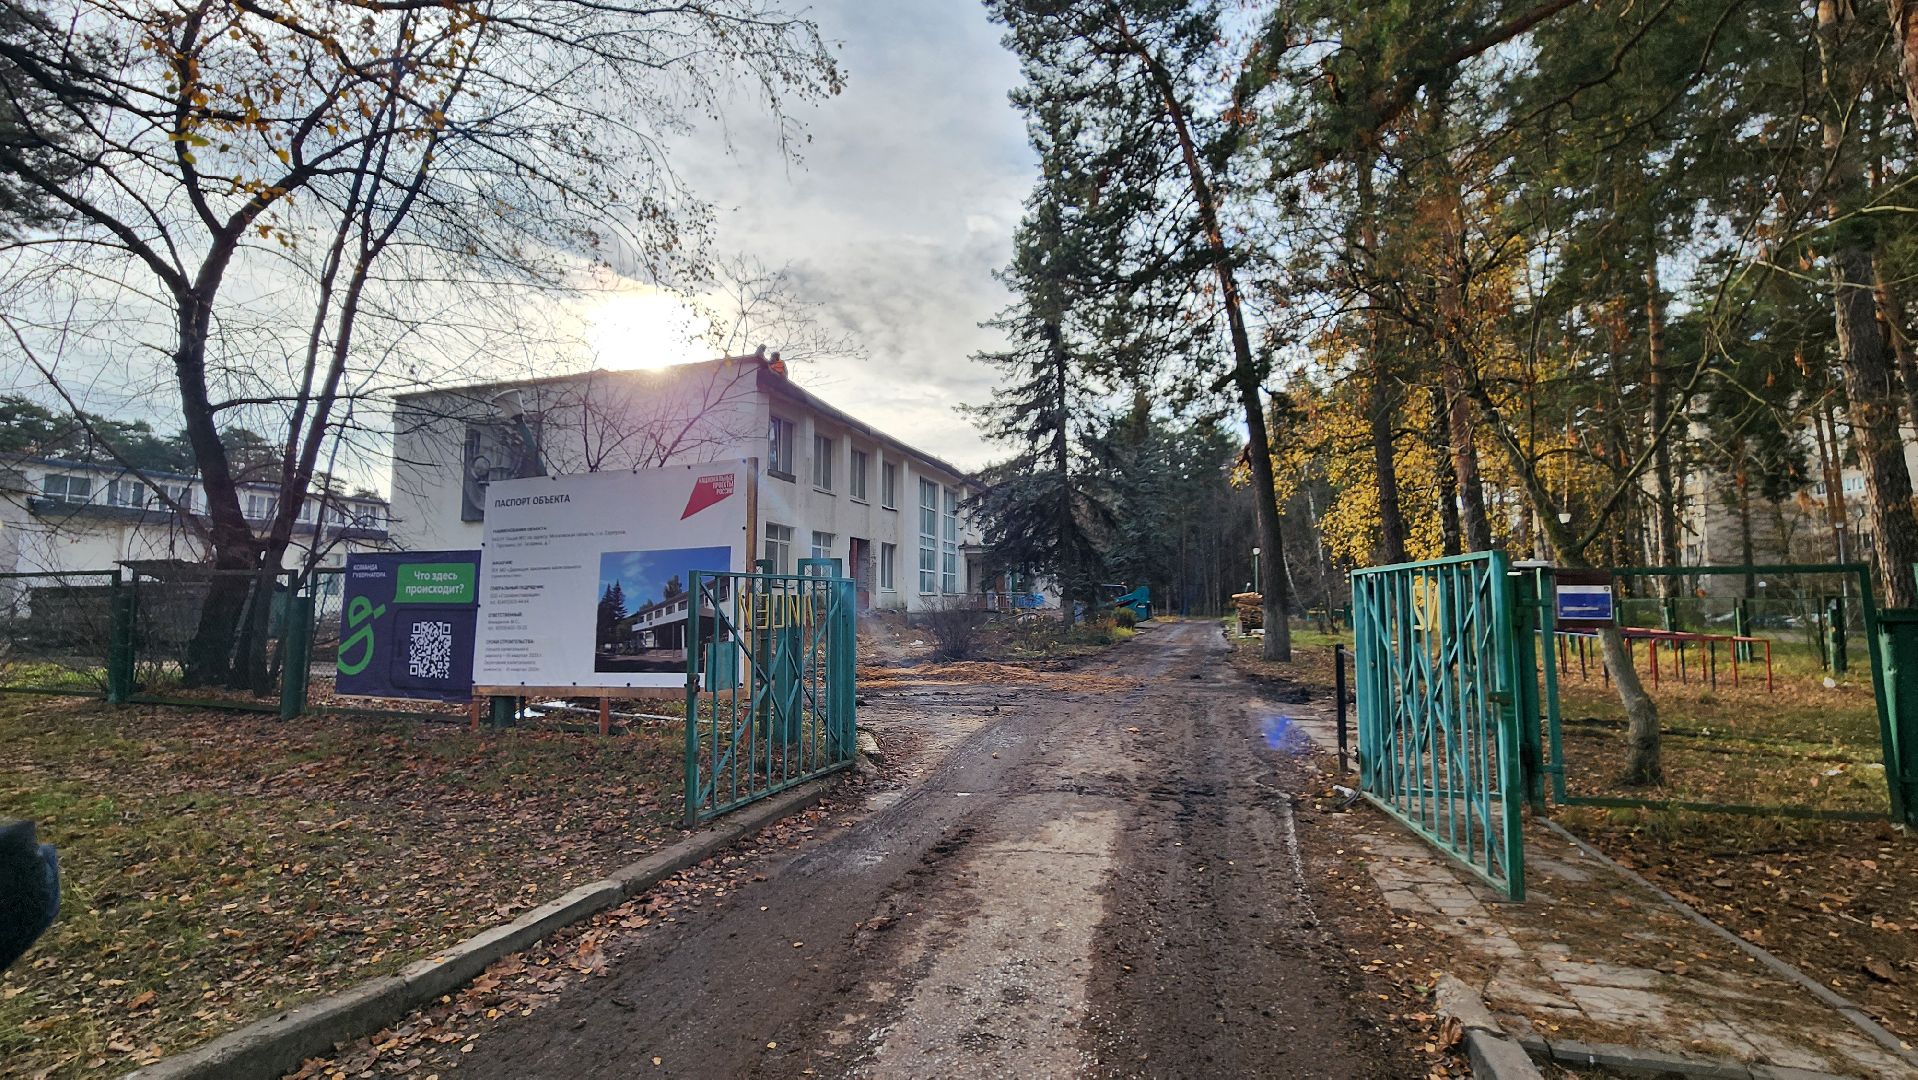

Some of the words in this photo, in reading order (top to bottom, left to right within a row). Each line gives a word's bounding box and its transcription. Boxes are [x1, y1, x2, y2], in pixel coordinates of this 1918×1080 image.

[494, 497, 531, 508] ПАСПОРТ
[532, 494, 571, 505] ОБЪЕКТА
[353, 563, 378, 571] КОМАНДА
[352, 571, 386, 579] ГУБЕРНАТОРА
[414, 571, 430, 580] Что
[431, 571, 458, 582] здесь
[405, 583, 464, 596] происходит?
